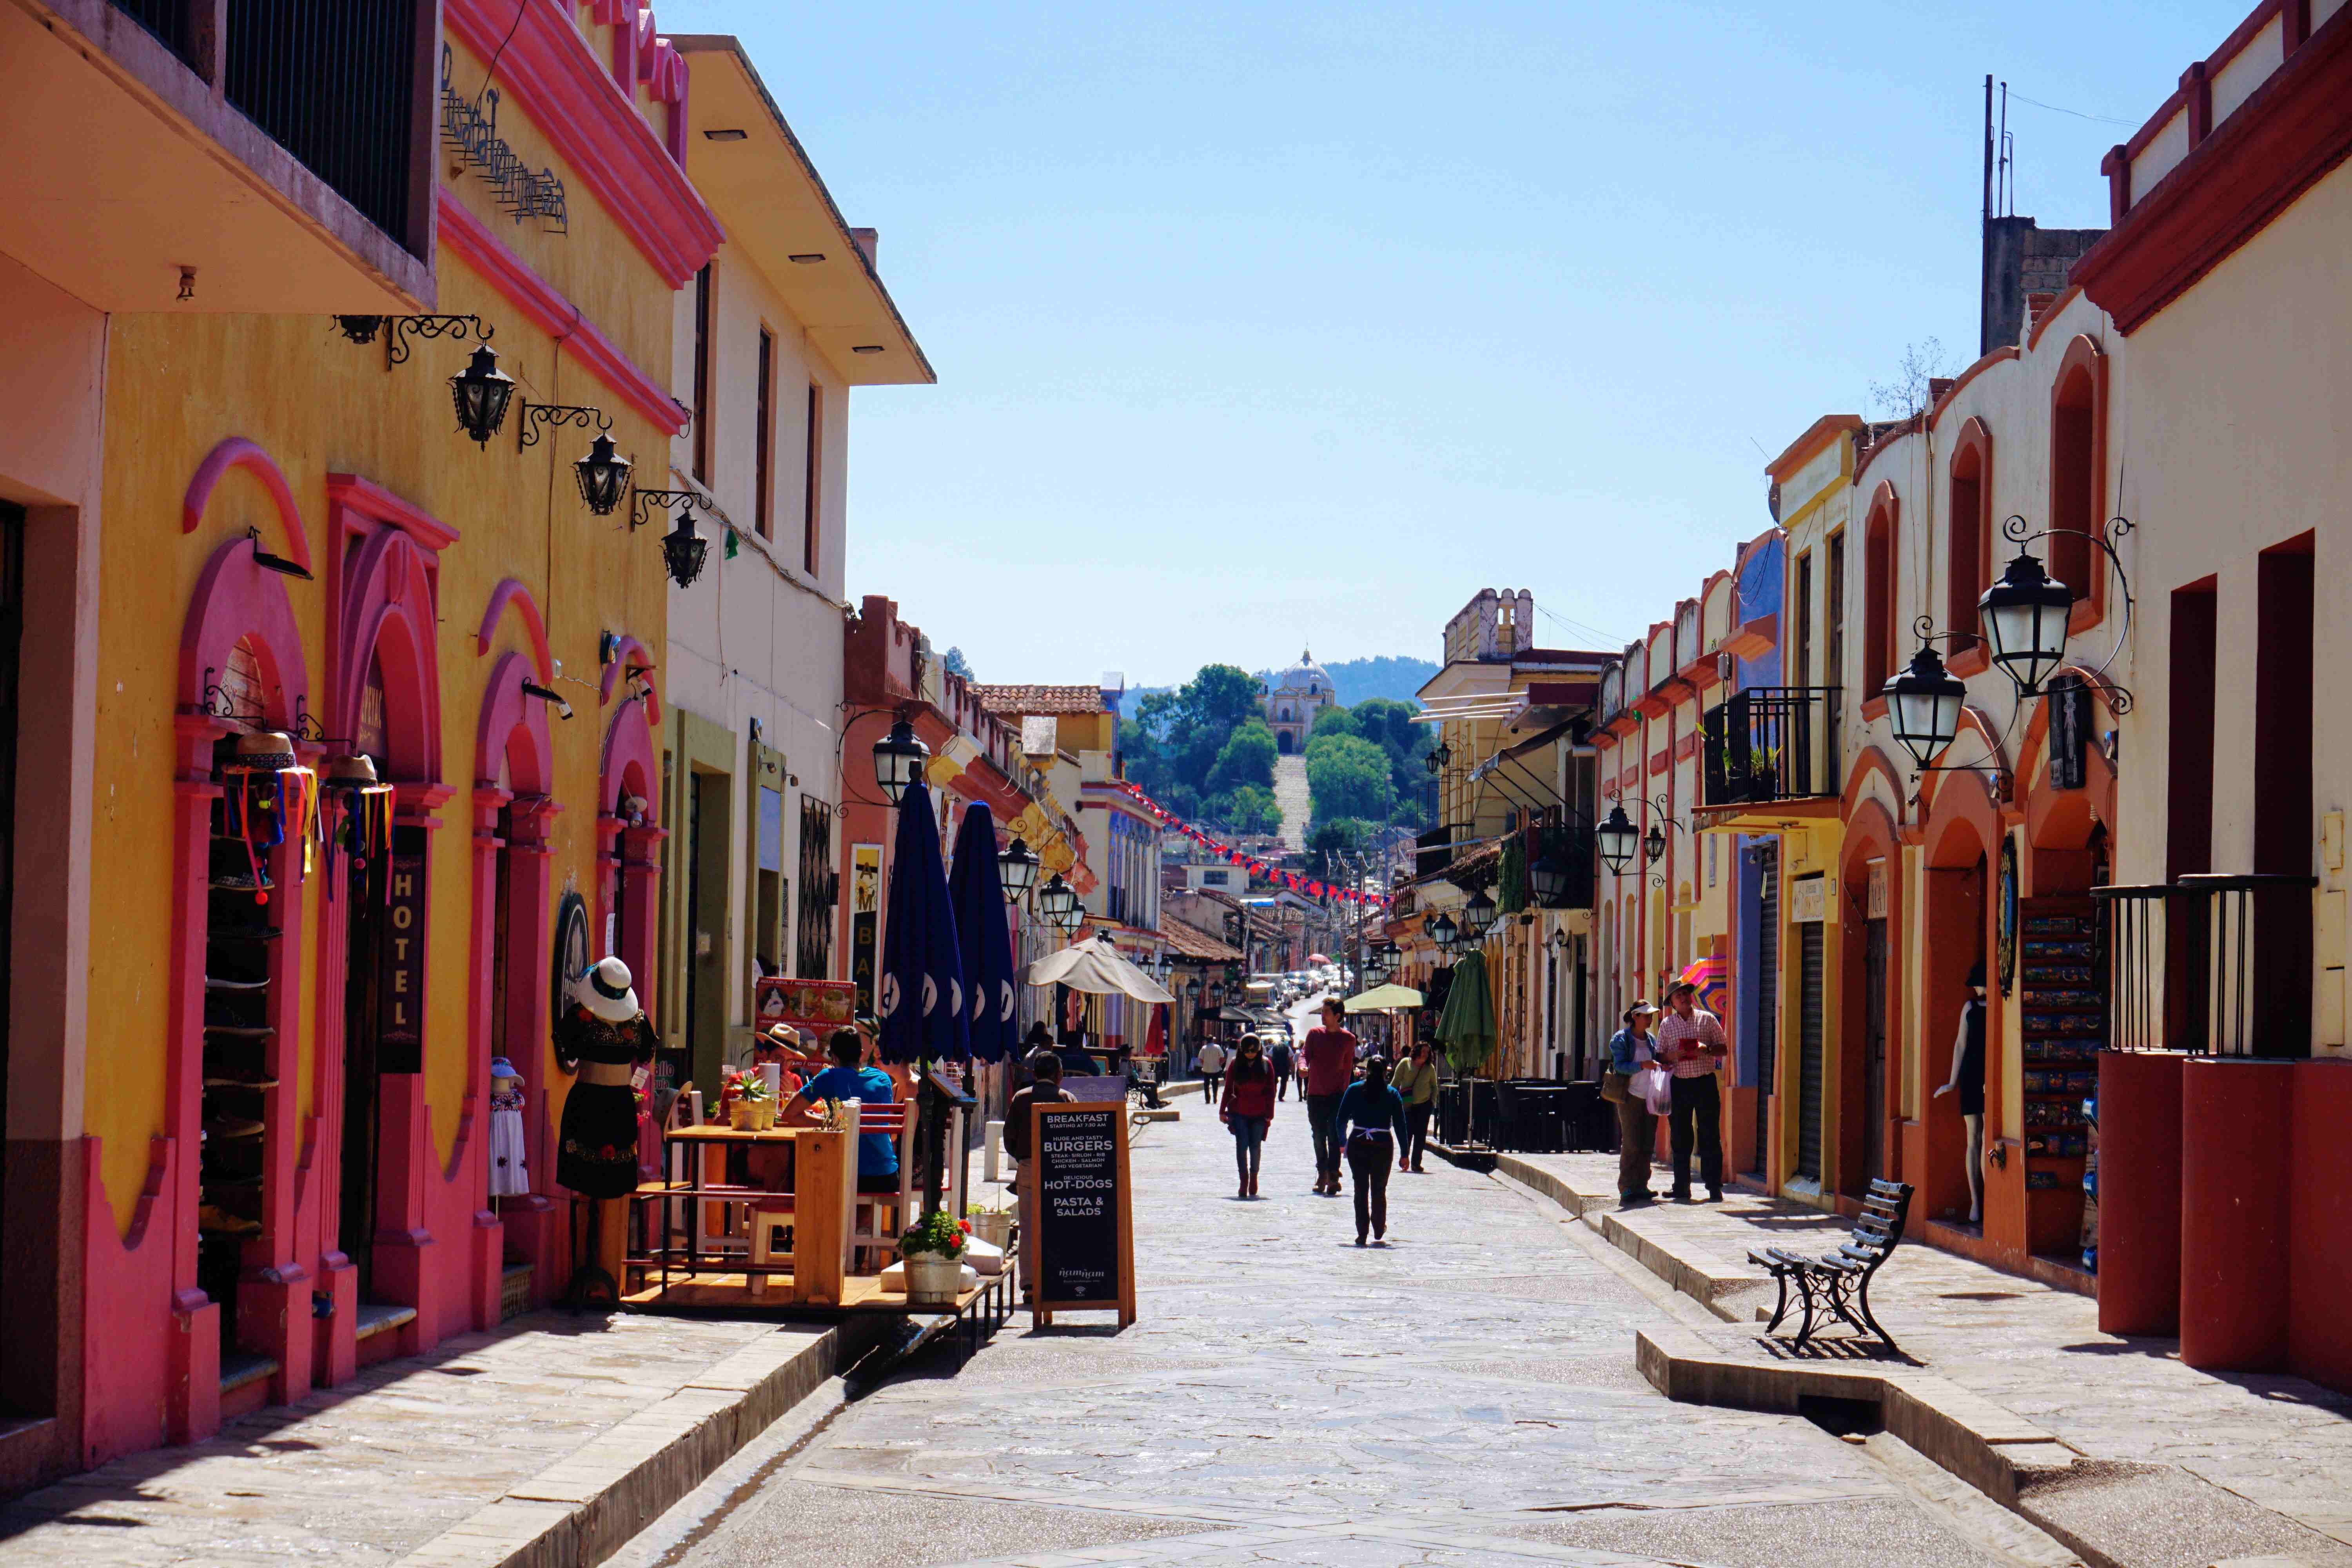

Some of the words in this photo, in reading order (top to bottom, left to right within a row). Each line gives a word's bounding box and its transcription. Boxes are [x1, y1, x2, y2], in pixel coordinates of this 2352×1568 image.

[393, 874, 412, 1024] HOTEL
[1047, 1114, 1109, 1123] BREAKFAST
[1044, 1140, 1113, 1152] BURGERS
[1044, 1179, 1113, 1190] HOT-DOGS
[1054, 1197, 1092, 1207] PASTA
[1096, 1196, 1103, 1206] &
[1056, 1207, 1101, 1216] SALADS
